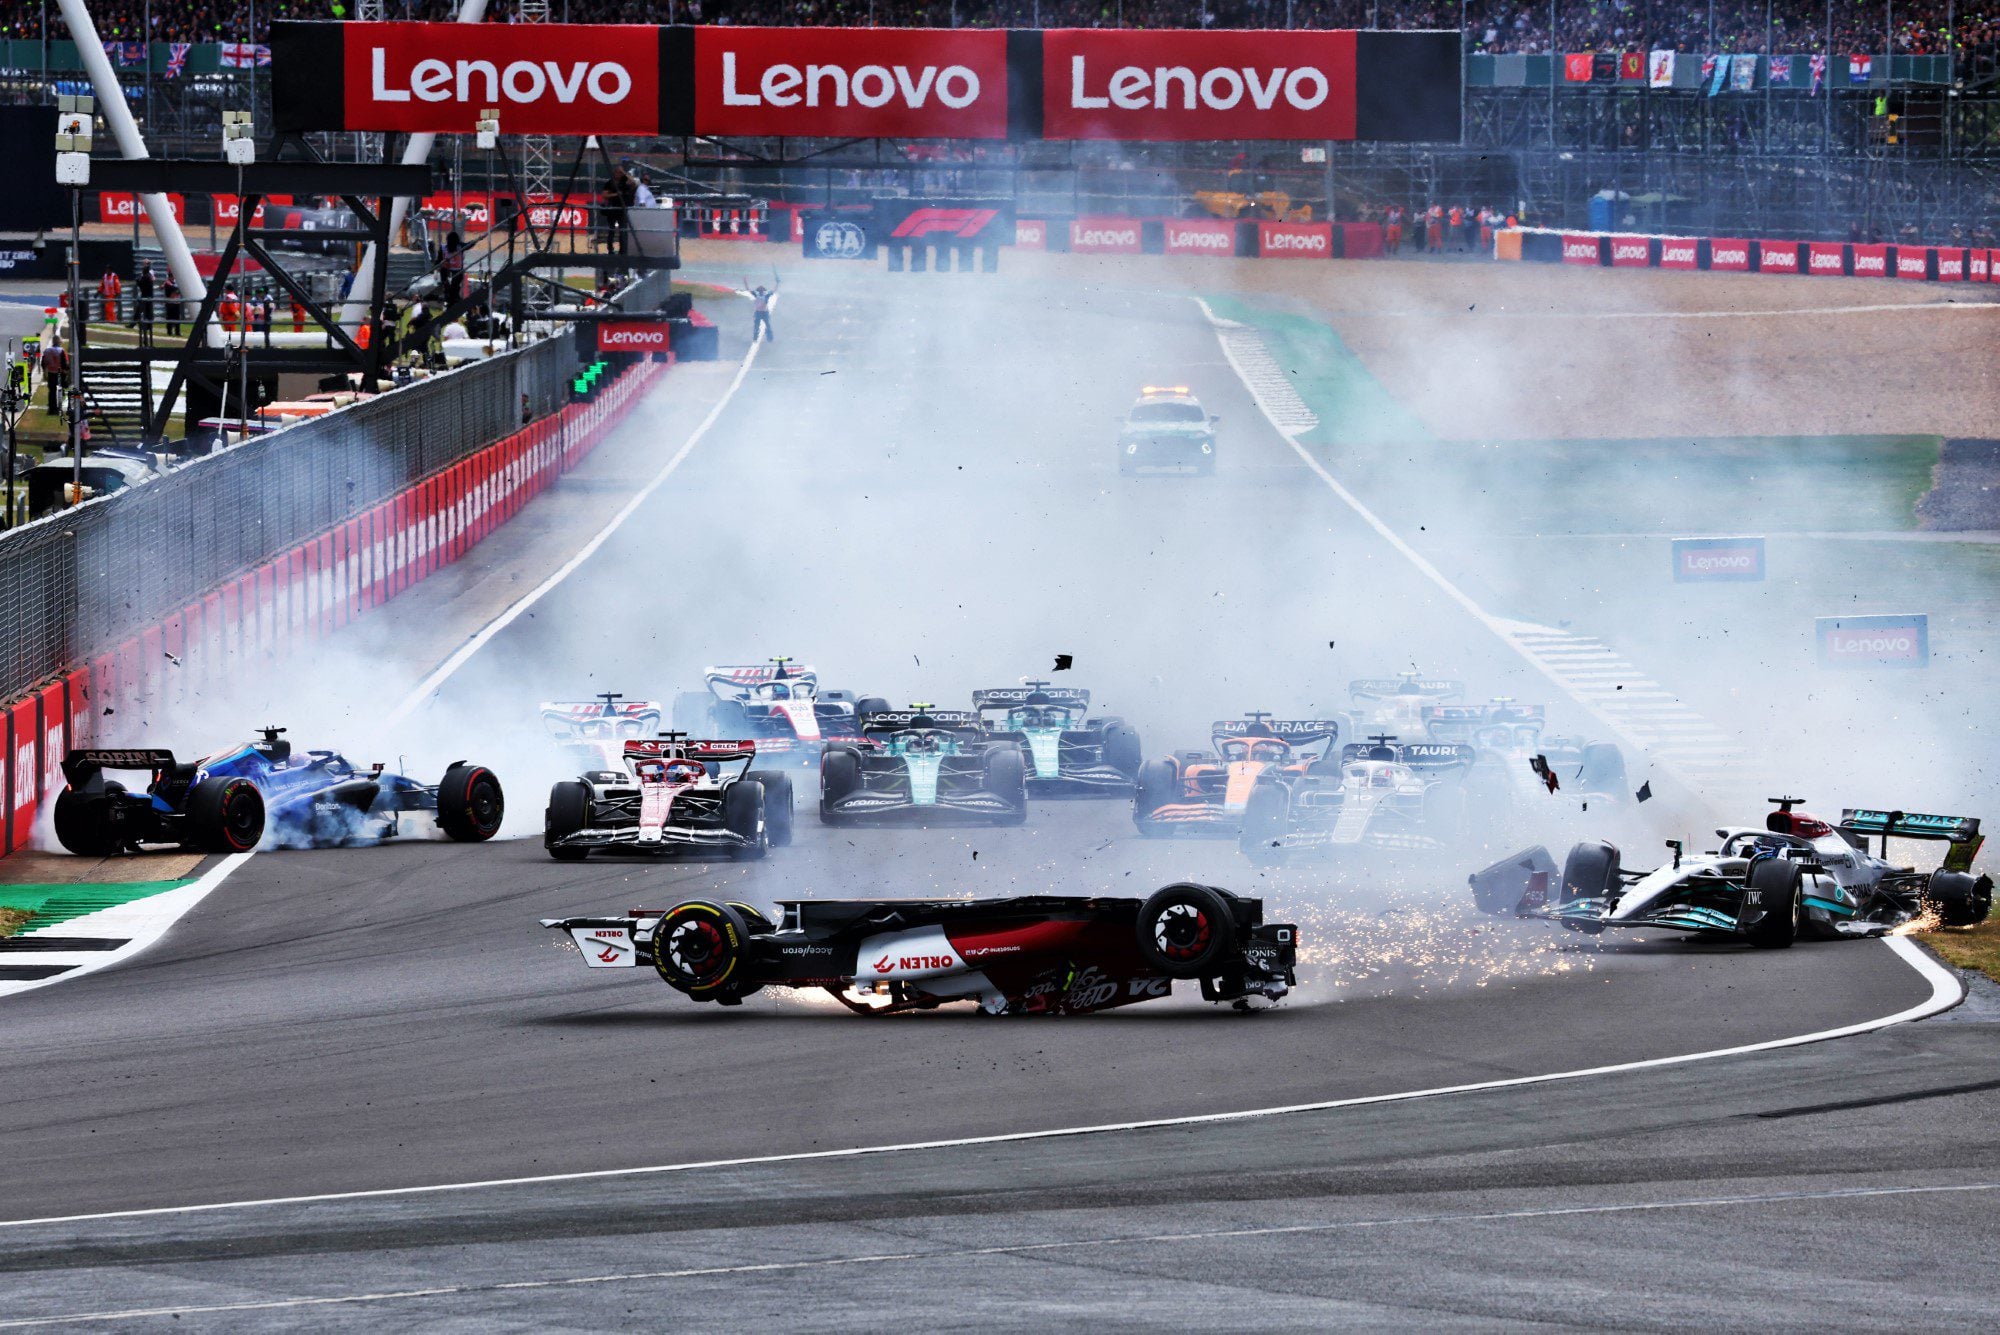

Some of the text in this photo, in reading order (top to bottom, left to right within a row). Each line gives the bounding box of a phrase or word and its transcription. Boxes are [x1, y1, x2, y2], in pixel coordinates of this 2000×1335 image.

[371, 46, 632, 104] Lenovo
[722, 51, 980, 109] Lenovo
[1070, 54, 1329, 111] Lenovo
[819, 230, 861, 251] FIA
[1073, 224, 1137, 247] Lenovo
[1168, 229, 1229, 250] Lenovo
[1264, 231, 1327, 251] Lenovo
[1563, 241, 1597, 259] Lenovo
[1711, 246, 1746, 264] Lenovo
[603, 329, 664, 344] Lenovo
[1686, 553, 1750, 569] Lenovo
[1834, 635, 1911, 653] Lenovo
[85, 751, 166, 766] SOFINA
[1747, 891, 1763, 905] IWC
[595, 930, 623, 938] ORLEN
[900, 954, 953, 970] ORLEN
[1127, 976, 1168, 996] 24
